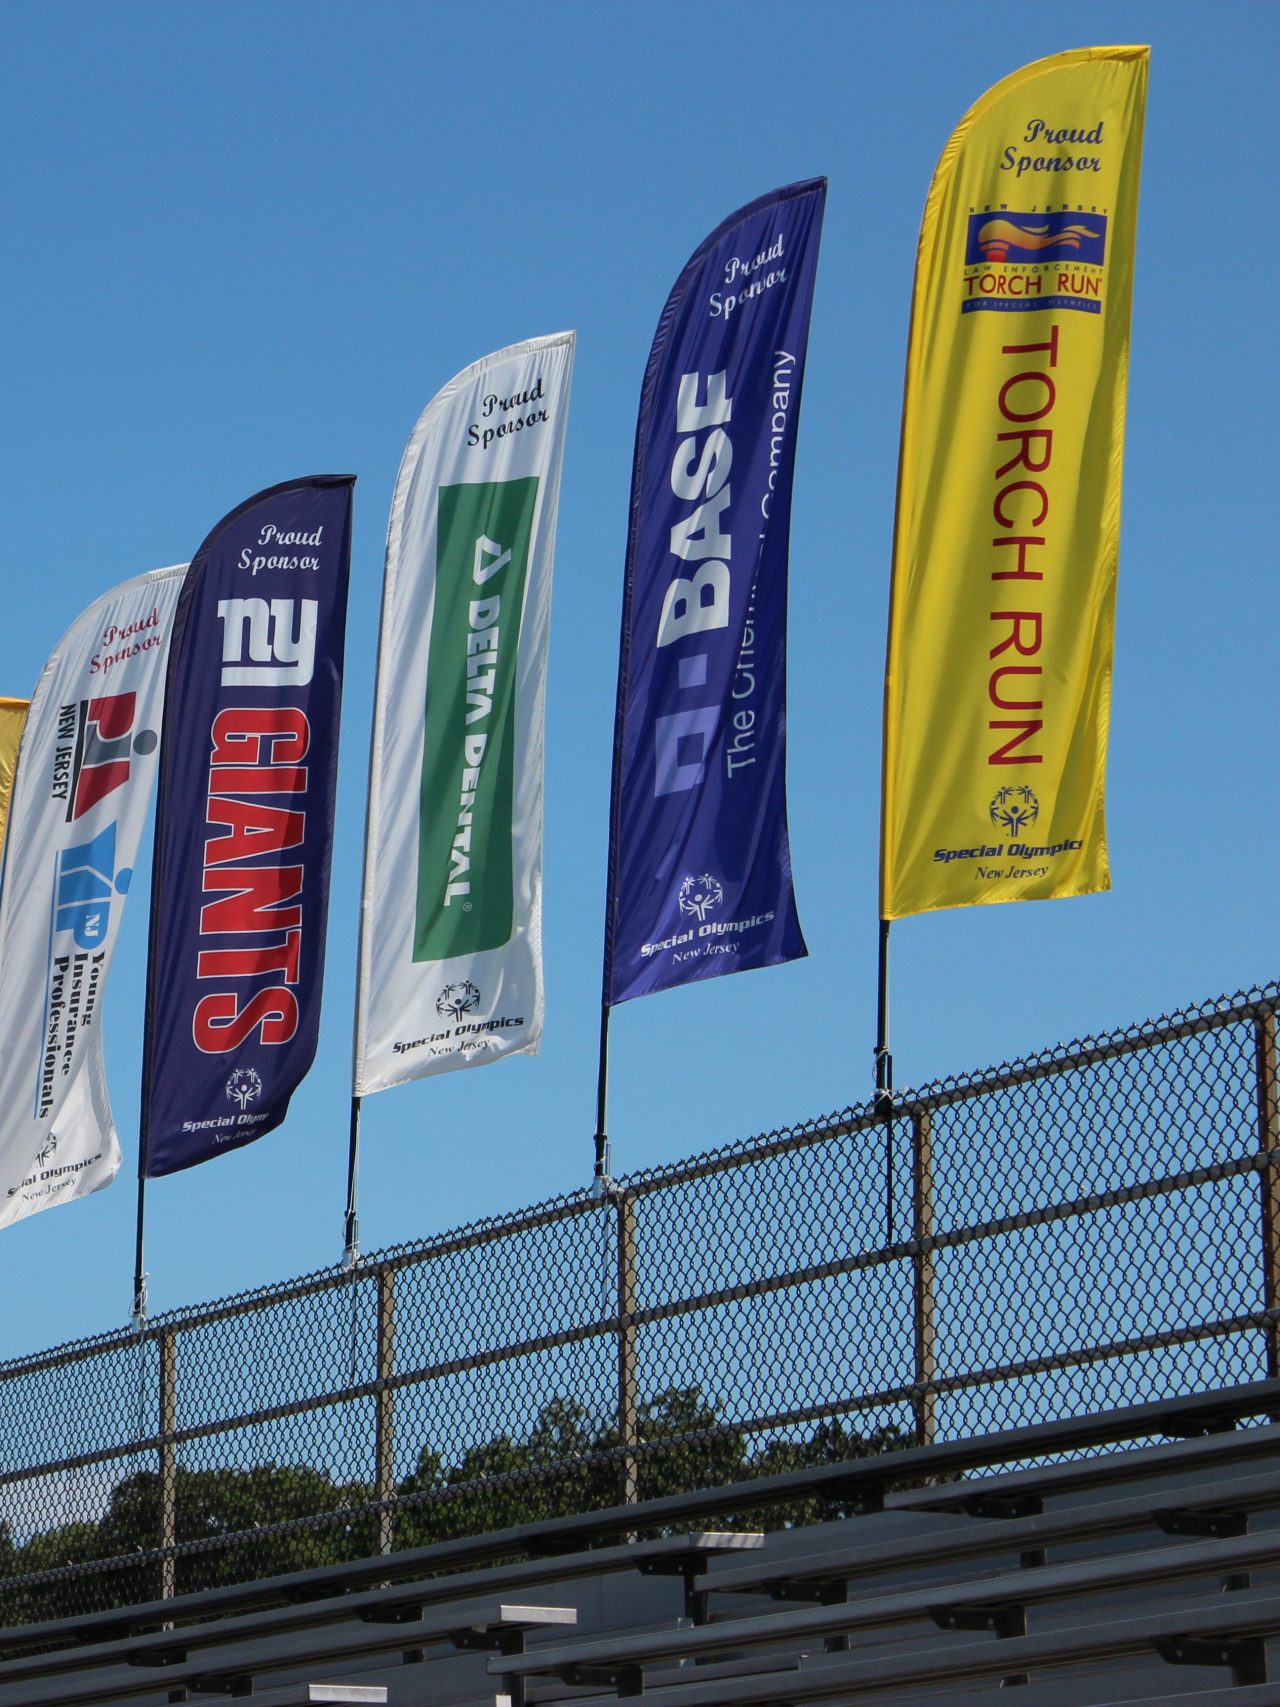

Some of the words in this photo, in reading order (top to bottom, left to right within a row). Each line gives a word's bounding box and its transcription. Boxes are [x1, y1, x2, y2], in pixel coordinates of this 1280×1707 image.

[1024, 118, 1104, 144] Proud
[1000, 146, 1101, 178] Sponsor
[969, 203, 1009, 215] NEW
[1030, 203, 1109, 216] JERSEY
[724, 233, 785, 284] Proud
[964, 265, 992, 275] LAW
[1003, 263, 1103, 275] ENFORCEMENT
[963, 273, 1042, 296] TORCH
[1057, 272, 1099, 296] RUN
[482, 378, 545, 417] Proud
[991, 325, 1059, 581] TORCH
[657, 369, 733, 648] BASF
[257, 524, 323, 546] Proud
[238, 548, 320, 576] Sponsor
[103, 607, 160, 648] Proud
[466, 594, 500, 725] DELTA
[988, 611, 1044, 766] RUN
[58, 703, 77, 739] NEW
[727, 709, 756, 778] The
[52, 746, 73, 800] JERSEY
[444, 733, 487, 907] DENTAL
[933, 844, 1004, 863] Special
[1007, 839, 1083, 859] Olympics
[193, 707, 311, 1054] GIANTS
[974, 866, 1004, 879] New
[1005, 866, 1049, 880] Jersey
[84, 913, 100, 937] NJ
[641, 929, 694, 957] Special
[698, 910, 775, 937] Olympics
[672, 947, 701, 965] New
[703, 942, 740, 956] Jersey
[81, 951, 105, 1026] Young
[61, 953, 89, 1076] Insurance
[39, 954, 70, 1119] Professionals
[392, 1030, 451, 1054] Special
[455, 1016, 524, 1036] Olympics
[427, 1045, 455, 1057] New
[457, 1037, 491, 1052] Jersey
[182, 1114, 236, 1132] Special
[40, 1153, 102, 1180] Olympics
[22, 1189, 43, 1202] New
[45, 1178, 77, 1194] Jersey
